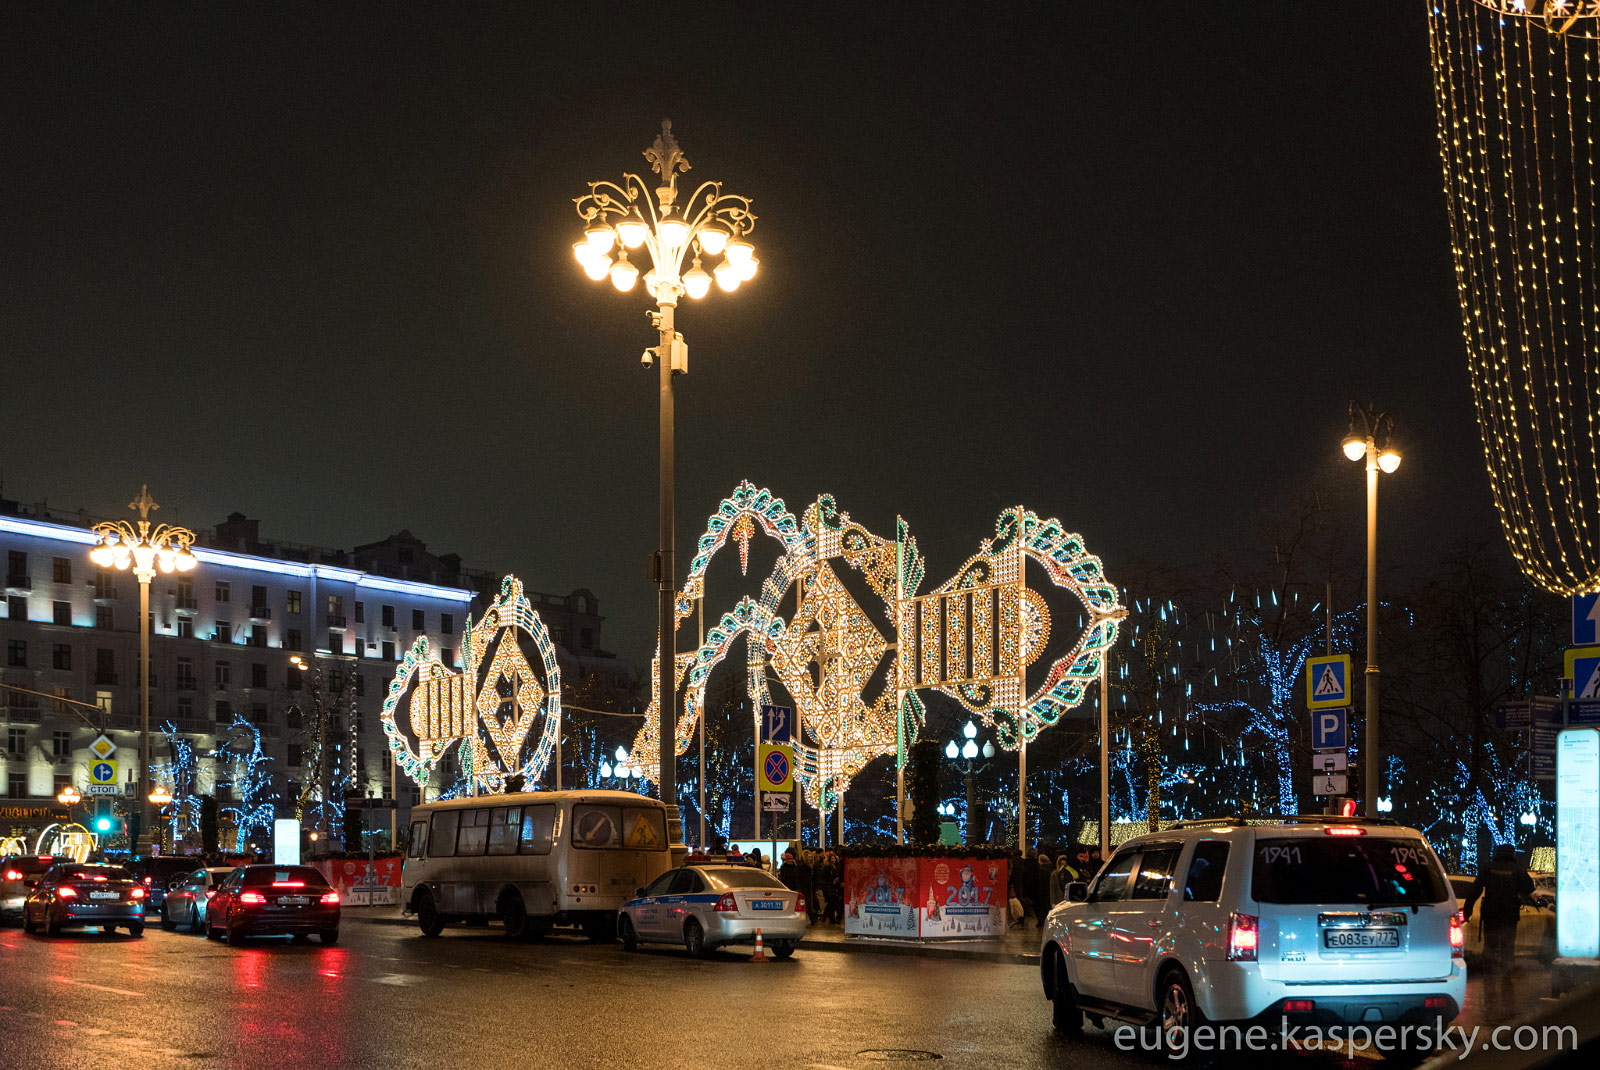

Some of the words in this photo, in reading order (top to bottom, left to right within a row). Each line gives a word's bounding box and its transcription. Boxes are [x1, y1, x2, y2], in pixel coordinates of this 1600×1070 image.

[1320, 714, 1339, 744] P
[1259, 846, 1302, 864] 1941
[1390, 846, 1429, 866] 1945
[865, 886, 905, 906] 2017
[945, 885, 993, 906] 2017
[1377, 932, 1394, 942] 777
